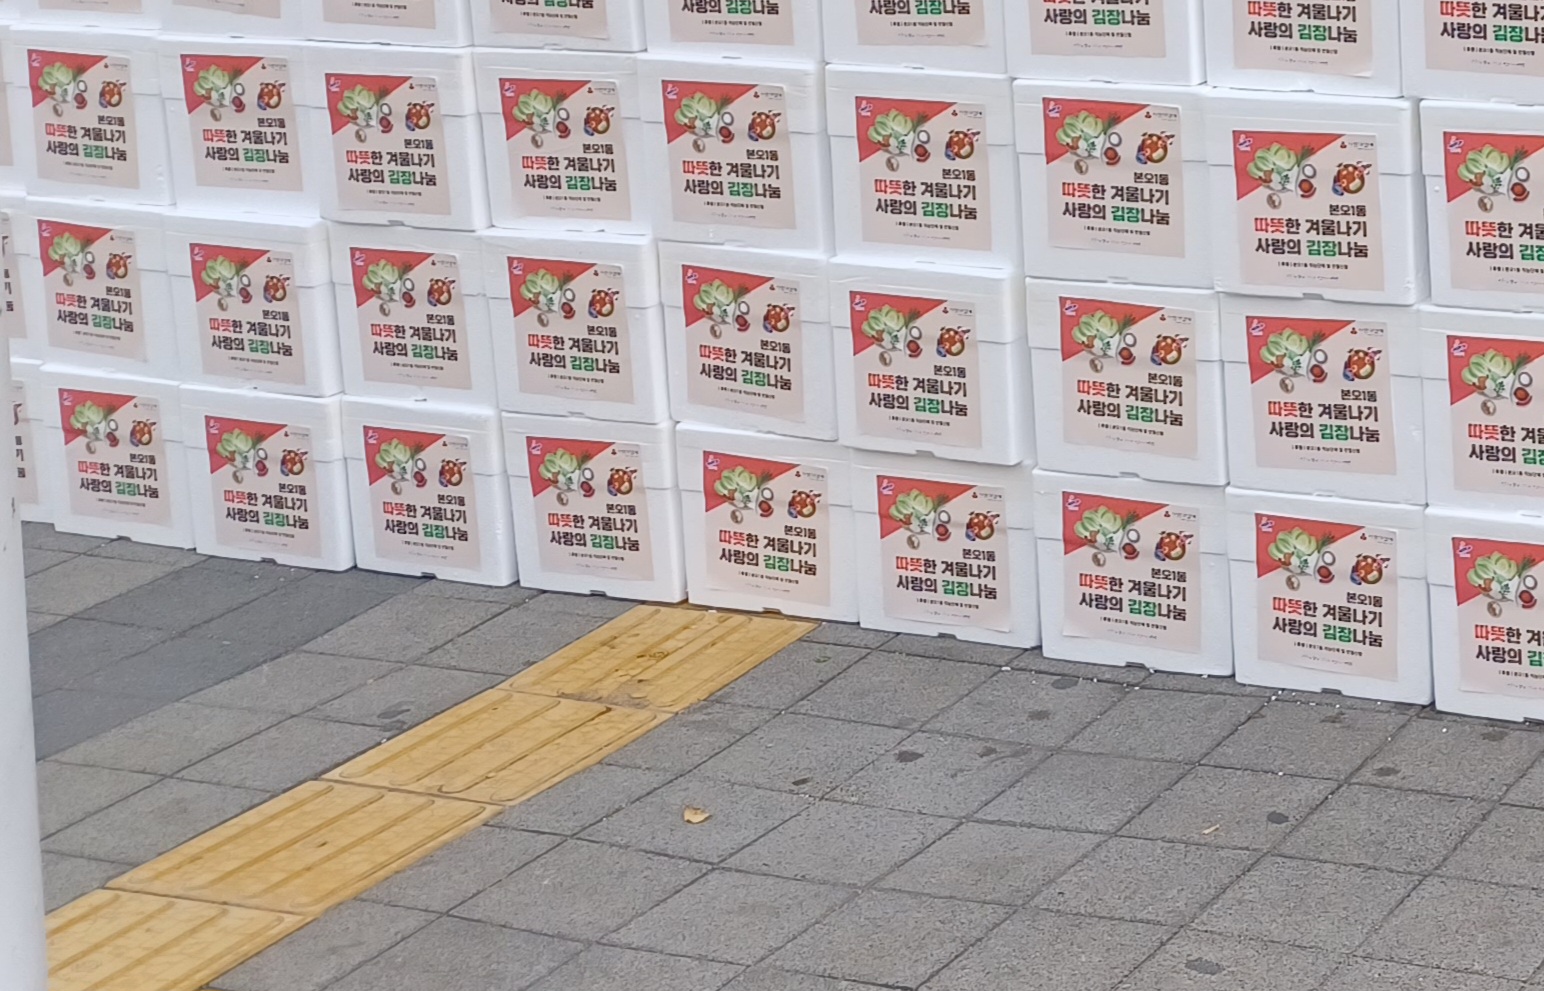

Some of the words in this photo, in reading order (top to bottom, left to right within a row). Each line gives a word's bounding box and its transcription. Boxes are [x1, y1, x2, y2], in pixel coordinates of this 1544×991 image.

[1246, 0, 1293, 18] 따뜻한
[1296, 3, 1357, 22] 겨울나기
[1247, 21, 1294, 38] 사랑의
[1297, 24, 1358, 43] 김장나눔
[345, 149, 384, 165] 따뜻한
[385, 151, 436, 167] 겨울나기
[347, 168, 386, 183] 사랑의
[387, 170, 438, 186] 김장나눔
[1061, 181, 1106, 200] 따뜻한
[1110, 185, 1170, 205] 겨울나기
[1062, 202, 1107, 220] 사랑의
[1110, 205, 1171, 225] 김장나눔
[1464, 220, 1514, 238] 따뜻한
[1465, 241, 1515, 259] 사랑의
[527, 333, 566, 351] 따뜻한
[568, 337, 619, 355] 겨울나기
[528, 352, 567, 369] 사랑의
[569, 355, 621, 374] 김장나눔
[867, 372, 909, 391] 따뜻한
[912, 377, 967, 397] 겨울나기
[868, 392, 910, 410] 사랑의
[913, 396, 968, 417] 김장나눔
[1267, 400, 1314, 418] 따뜻한
[1317, 403, 1379, 422] 겨울나기
[1268, 421, 1315, 438] 사랑의
[1318, 424, 1381, 442] 김장나눔
[77, 460, 111, 476] 따뜻한
[112, 464, 158, 482] 겨울나기
[79, 477, 113, 493] 사랑의
[114, 481, 160, 499] 김장나눔
[382, 501, 418, 518] 따뜻한
[420, 505, 467, 524] 겨울나기
[384, 519, 420, 536] 사랑의
[421, 523, 469, 542] 김장나눔
[718, 529, 760, 549] 따뜻한
[763, 536, 817, 558] 겨울나기
[719, 547, 760, 567] 사랑의
[763, 554, 817, 576] 김장나눔
[1078, 572, 1124, 593] 따뜻한
[1127, 579, 1187, 602] 겨울나기
[1079, 592, 1124, 612] 사랑의
[1127, 598, 1187, 621] 김장나눔
[1473, 623, 1522, 644] 따뜻한
[1474, 644, 1523, 664] 사랑의
